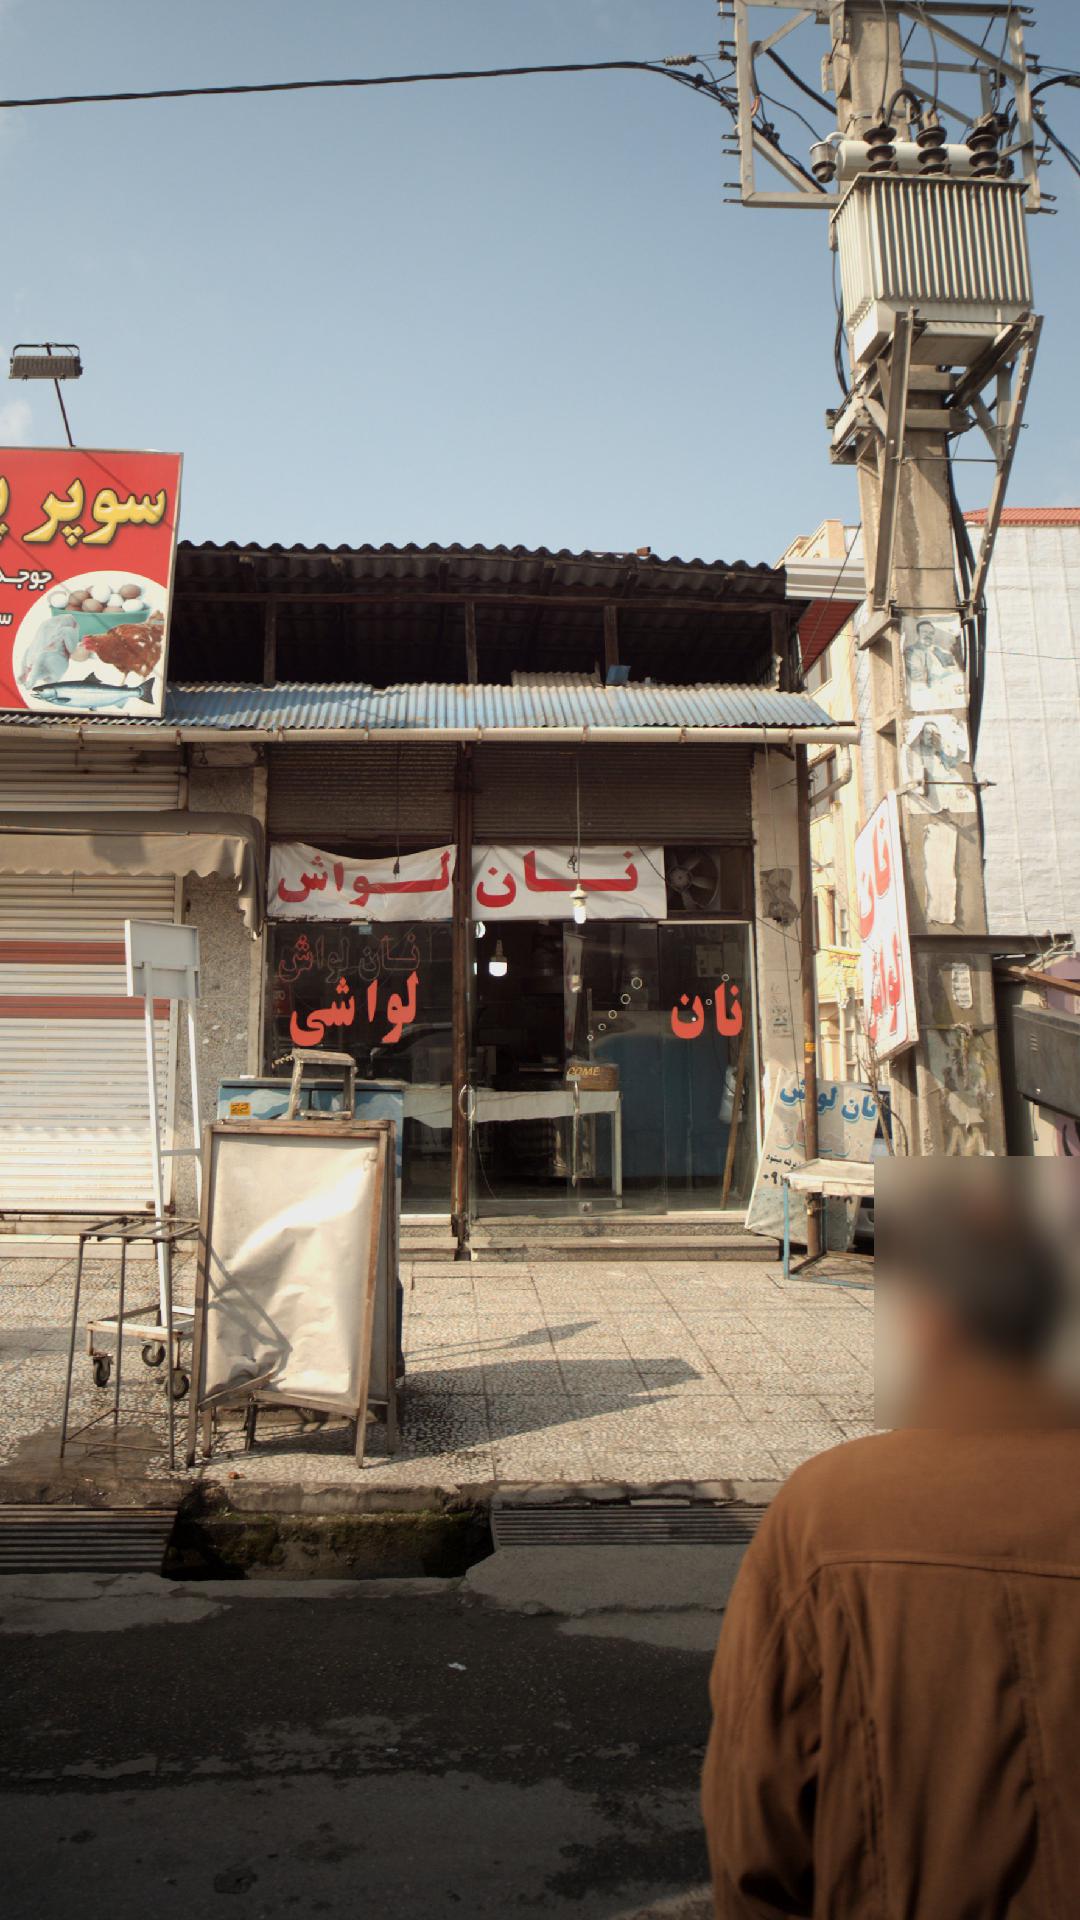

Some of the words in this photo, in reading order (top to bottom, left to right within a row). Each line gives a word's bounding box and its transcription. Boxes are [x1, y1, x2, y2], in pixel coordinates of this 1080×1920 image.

[22, 478, 167, 546] سوپر
[278, 851, 451, 907] لواش
[476, 850, 639, 908] نان
[671, 982, 743, 1039] نان
[780, 1079, 839, 1115] لوش
